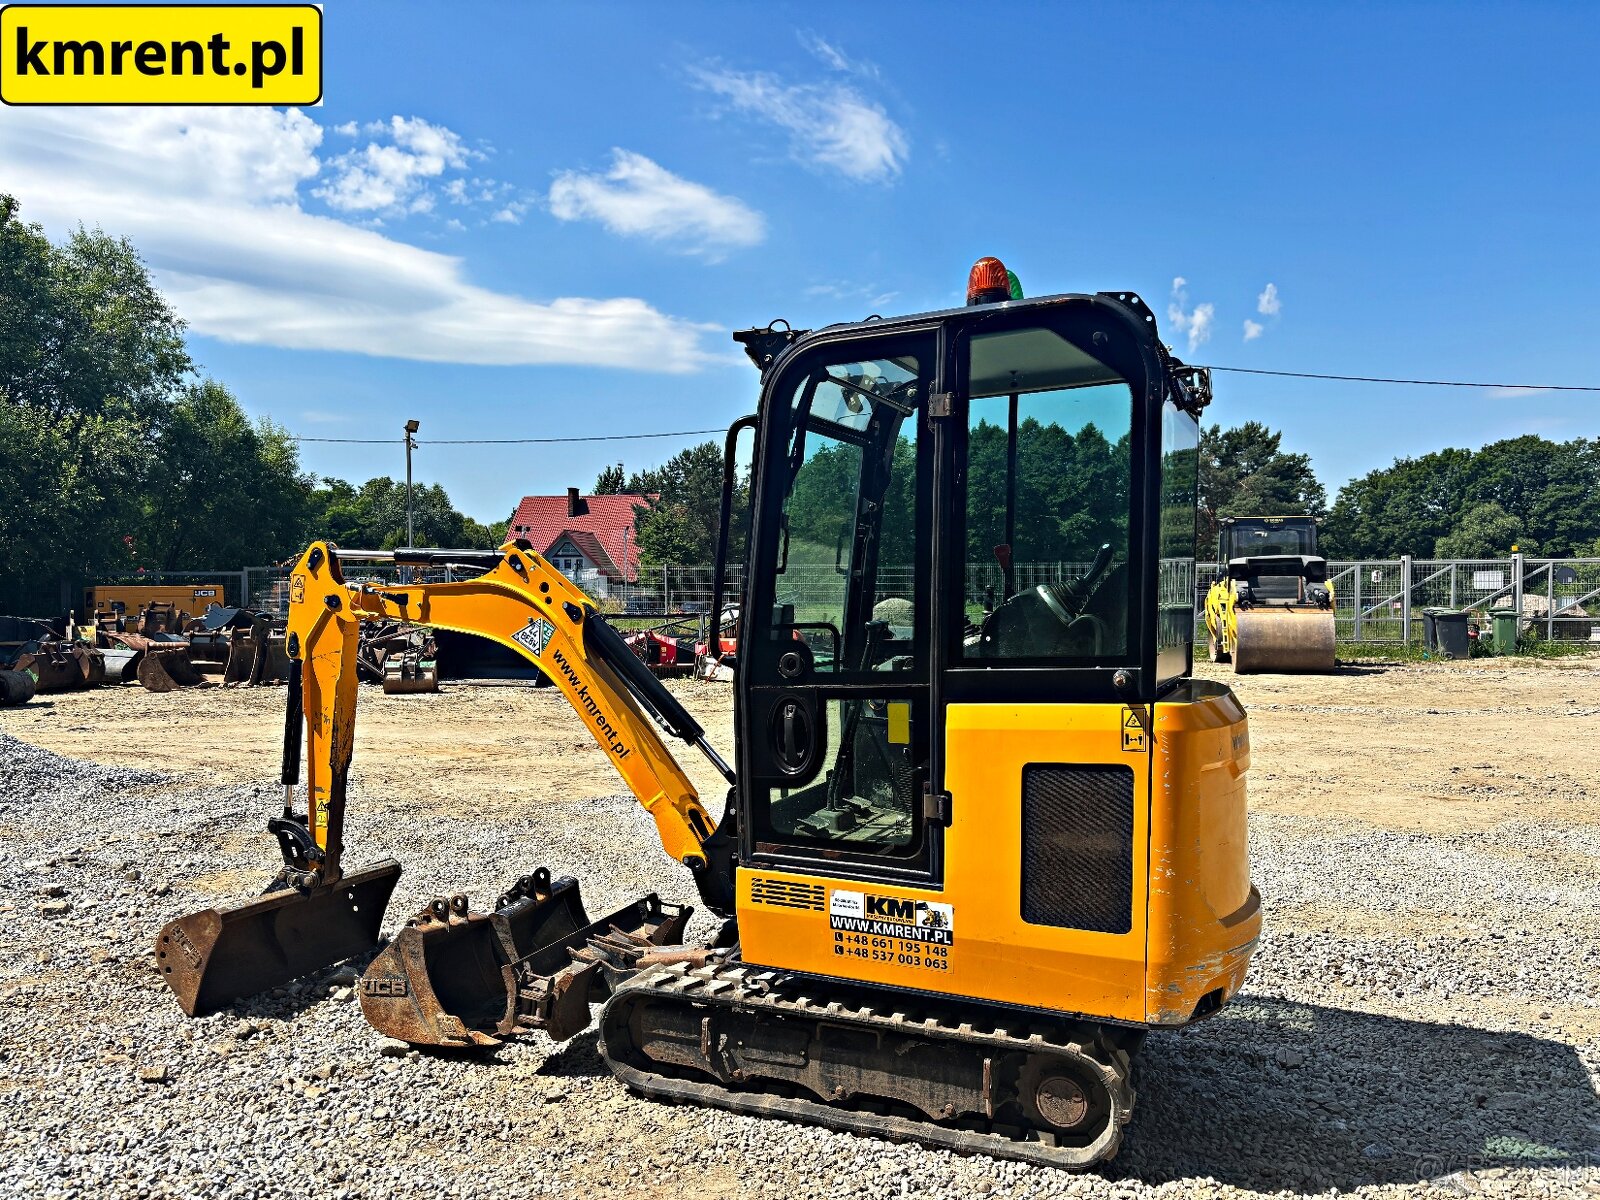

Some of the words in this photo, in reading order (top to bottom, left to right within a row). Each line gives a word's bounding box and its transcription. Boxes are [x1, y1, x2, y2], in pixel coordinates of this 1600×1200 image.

[553, 649, 630, 759] www.kmrent.pl
[866, 896, 913, 919] KM
[830, 915, 951, 944] WWW.KMRENT.PL
[846, 934, 868, 946] +48
[872, 938, 893, 949] 661
[898, 941, 920, 953] 195
[925, 945, 948, 957] 148
[846, 947, 869, 958] +48
[872, 951, 894, 961] 537
[898, 954, 921, 966] 003
[925, 957, 948, 970] 063
[362, 978, 408, 997] JCB
